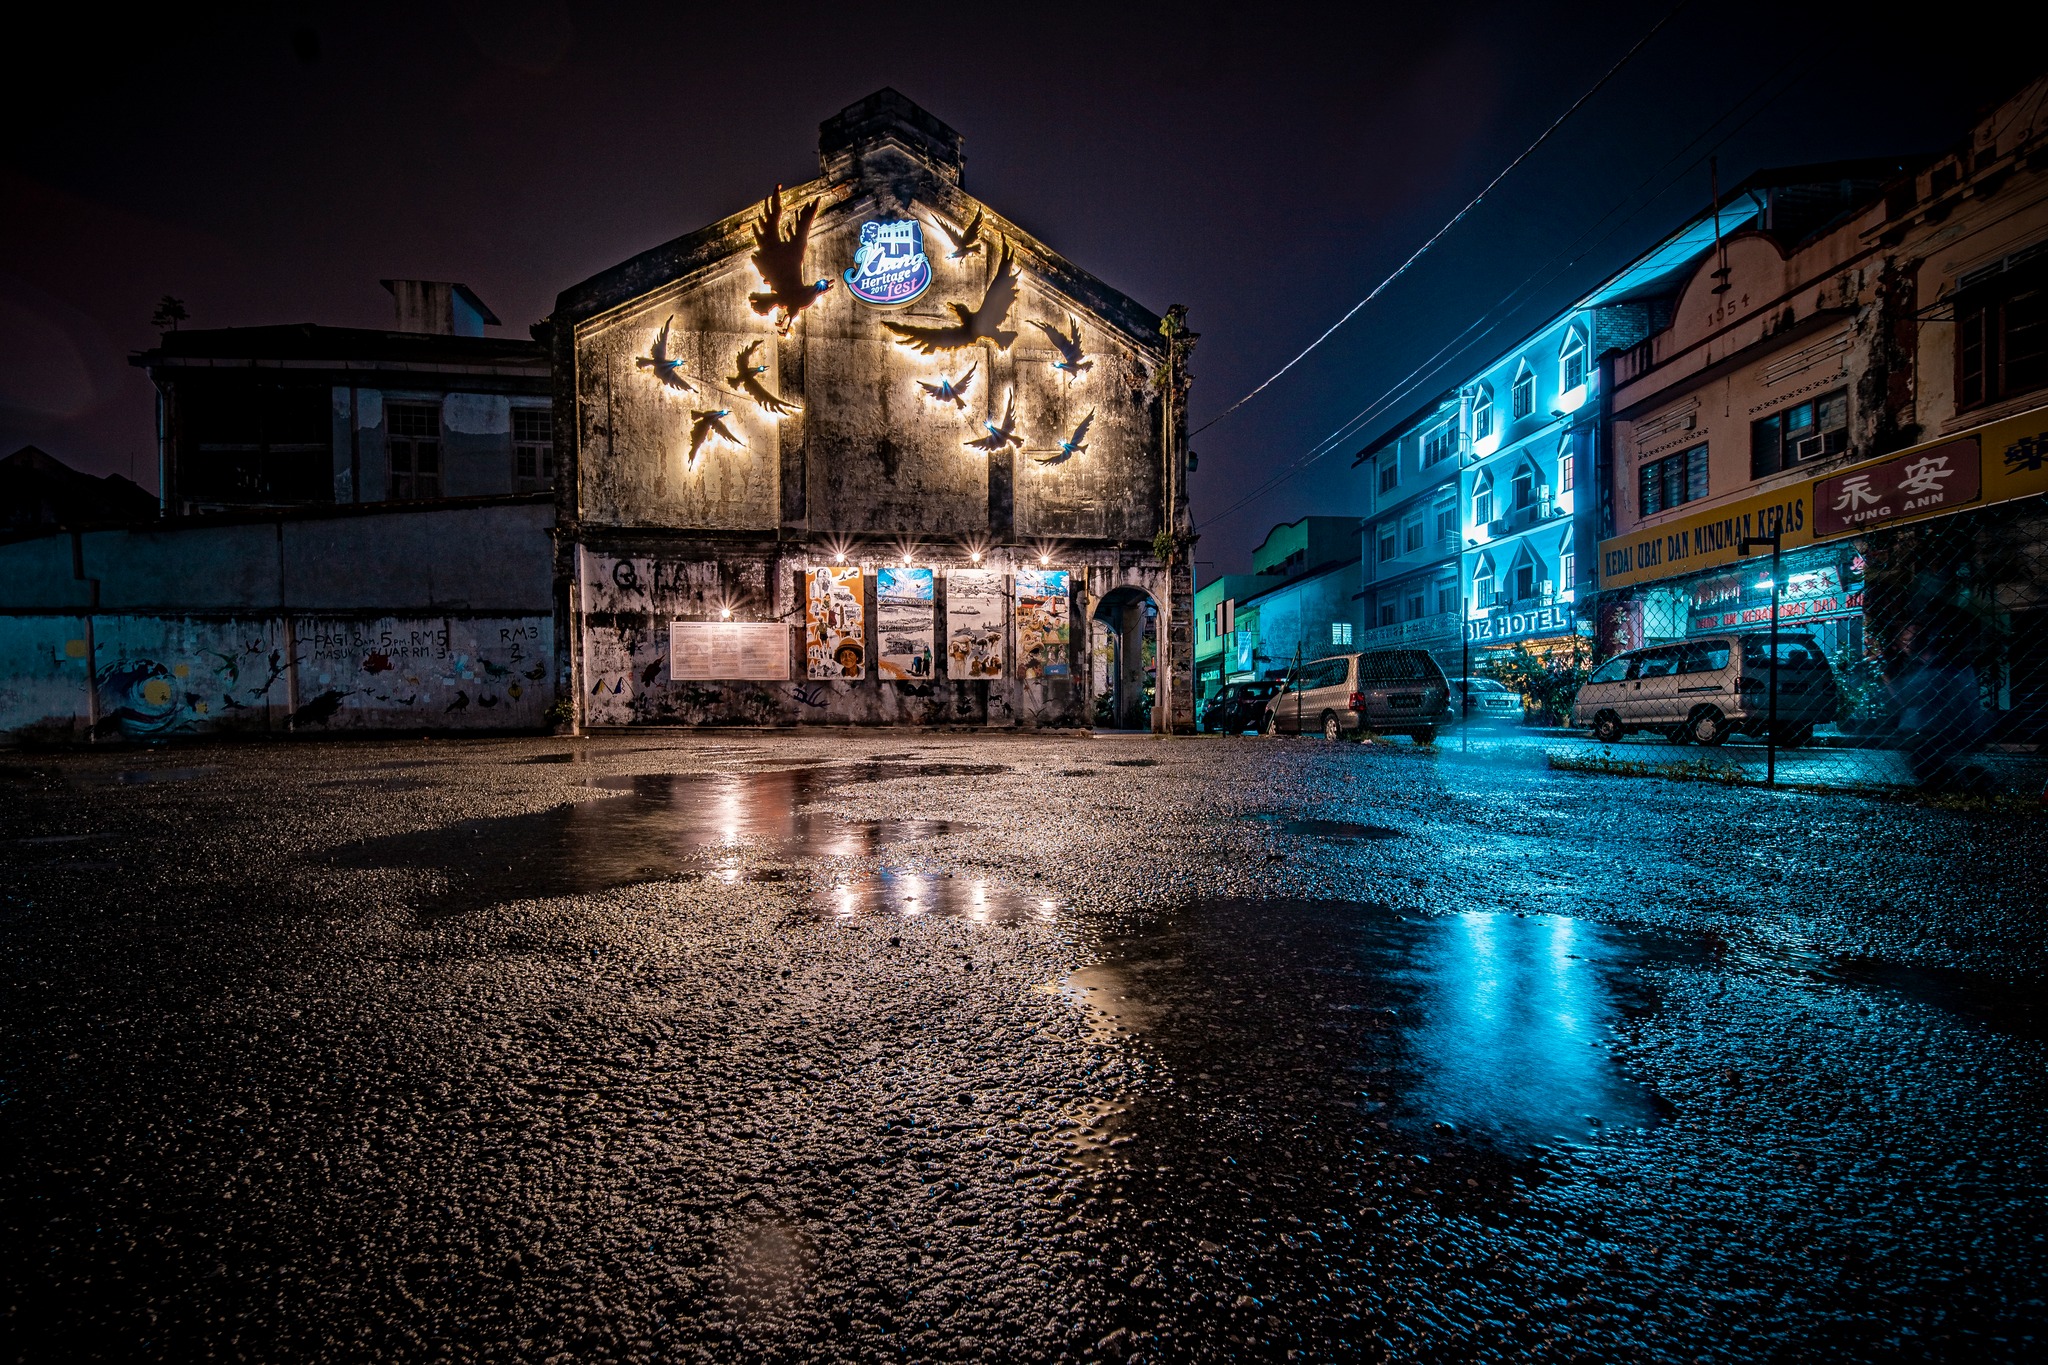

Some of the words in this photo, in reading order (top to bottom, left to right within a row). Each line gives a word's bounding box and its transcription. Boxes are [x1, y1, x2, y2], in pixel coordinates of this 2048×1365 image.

[860, 269, 912, 290] Heritage
[870, 285, 888, 295] 2017
[886, 277, 918, 301] fest
[1708, 293, 1751, 327] 1954
[1831, 455, 1955, 512] 永安
[1842, 505, 1892, 525] YUNG
[1903, 492, 1945, 511] ANN
[1605, 546, 1633, 577] KEDAI
[1637, 537, 1663, 569] UBAT
[1667, 530, 1689, 562] DAN
[1694, 513, 1751, 556] MINUMAN
[1757, 498, 1804, 539] KERAS
[1461, 619, 1492, 641] BIZ
[1496, 606, 1566, 637] HOTEL
